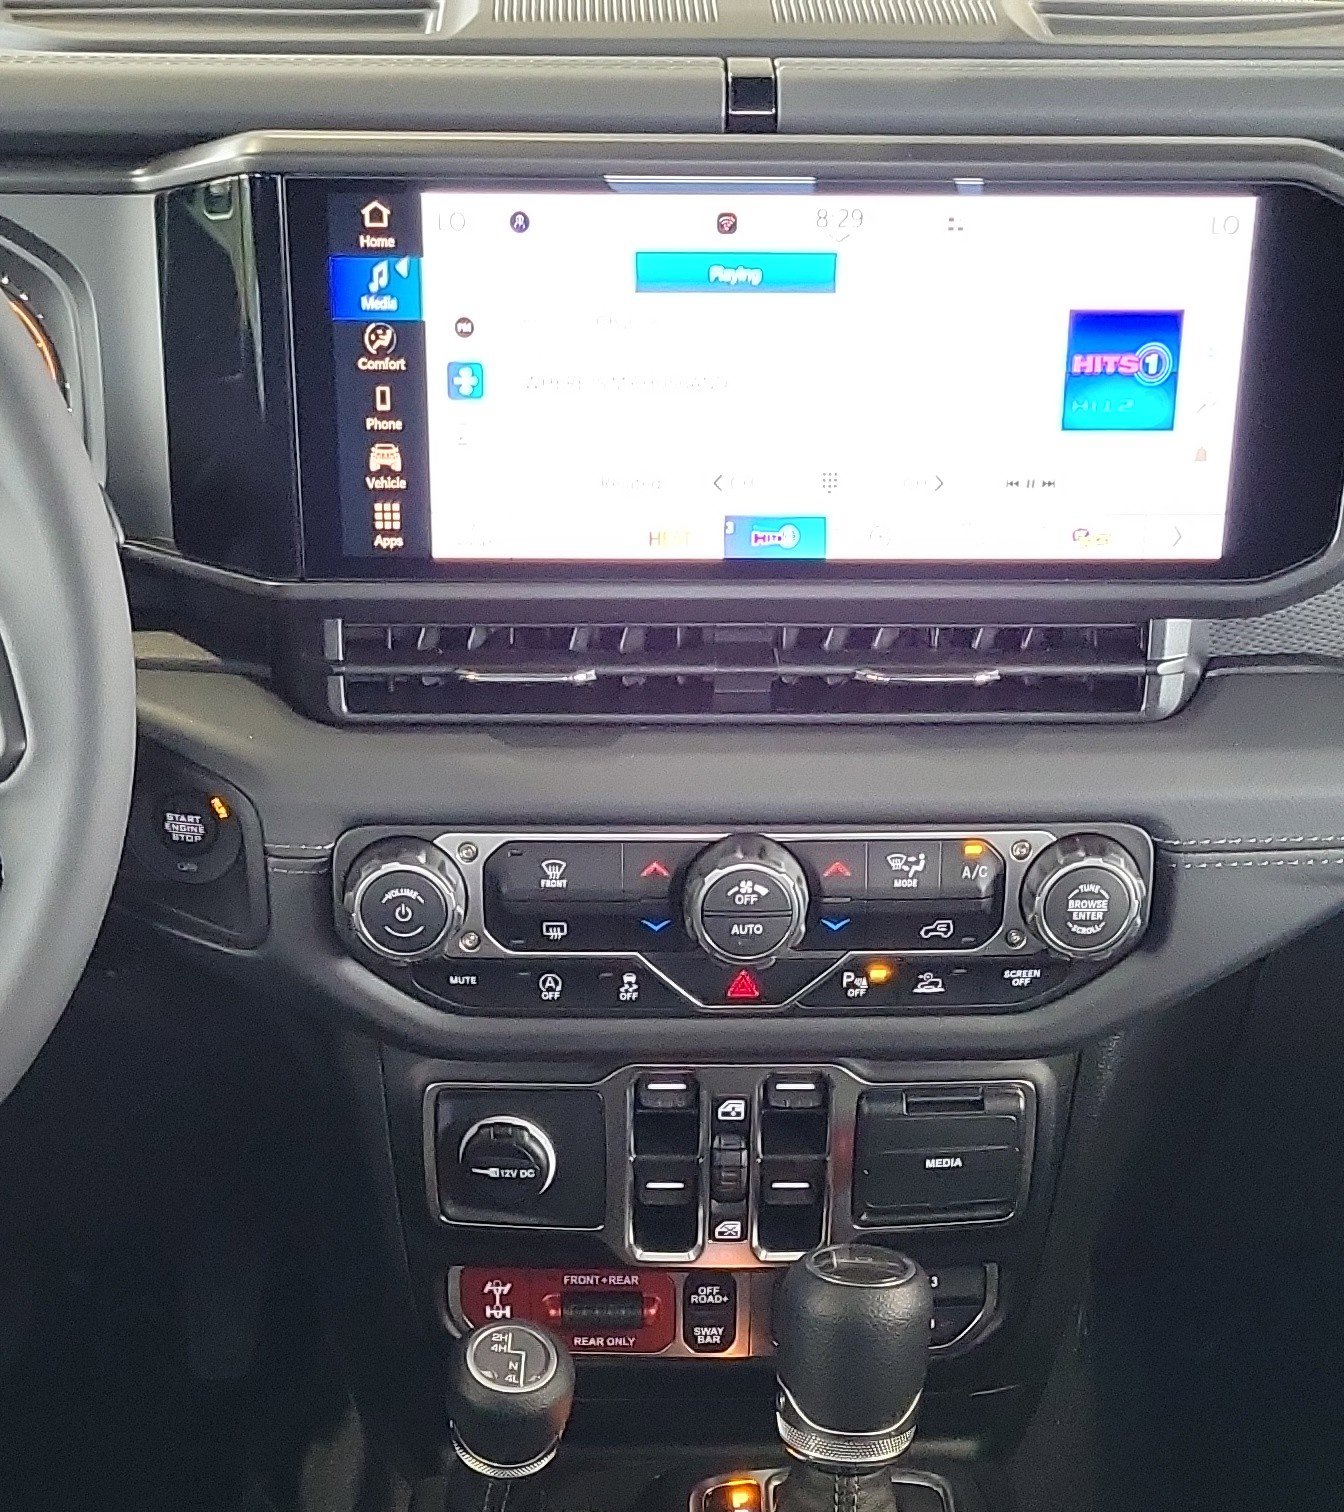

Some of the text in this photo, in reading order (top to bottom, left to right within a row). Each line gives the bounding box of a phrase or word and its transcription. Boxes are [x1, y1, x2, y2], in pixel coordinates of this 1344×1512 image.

[359, 234, 395, 248] Home
[361, 294, 398, 311] Media
[357, 356, 406, 370] Comfort
[366, 417, 403, 430] Phone
[365, 476, 407, 489] Vehicle
[373, 534, 404, 550] Apps
[166, 812, 201, 824] START
[164, 822, 205, 833] ENGINE
[172, 833, 202, 842] STOP
[962, 866, 988, 879] A/C
[541, 879, 567, 888] FRONT
[894, 879, 918, 888] MODE
[1079, 884, 1101, 893] TUNE
[735, 894, 758, 905] OFF
[1068, 900, 1108, 909] BROWSE
[1072, 912, 1104, 920] ENTER
[731, 924, 763, 935] AUTO
[1004, 969, 1041, 979] SCREEN
[449, 975, 477, 985] MUTE
[1012, 978, 1031, 987] OFF
[541, 991, 560, 1000] OFF
[619, 991, 640, 1001] OFF
[847, 988, 866, 998] OFF
[925, 1158, 962, 1168] MEDIA
[500, 1169, 535, 1178] 12V DC
[698, 1286, 719, 1295] OFF
[693, 1327, 724, 1336] SWAY
[492, 1333, 508, 1342] 2H
[574, 1336, 636, 1347] REAR ONLY
[697, 1335, 721, 1344] BAR
[491, 1343, 507, 1353] 4H
[508, 1361, 518, 1371] N
[505, 1374, 519, 1383] 4L
[732, 1492, 749, 1508] P
